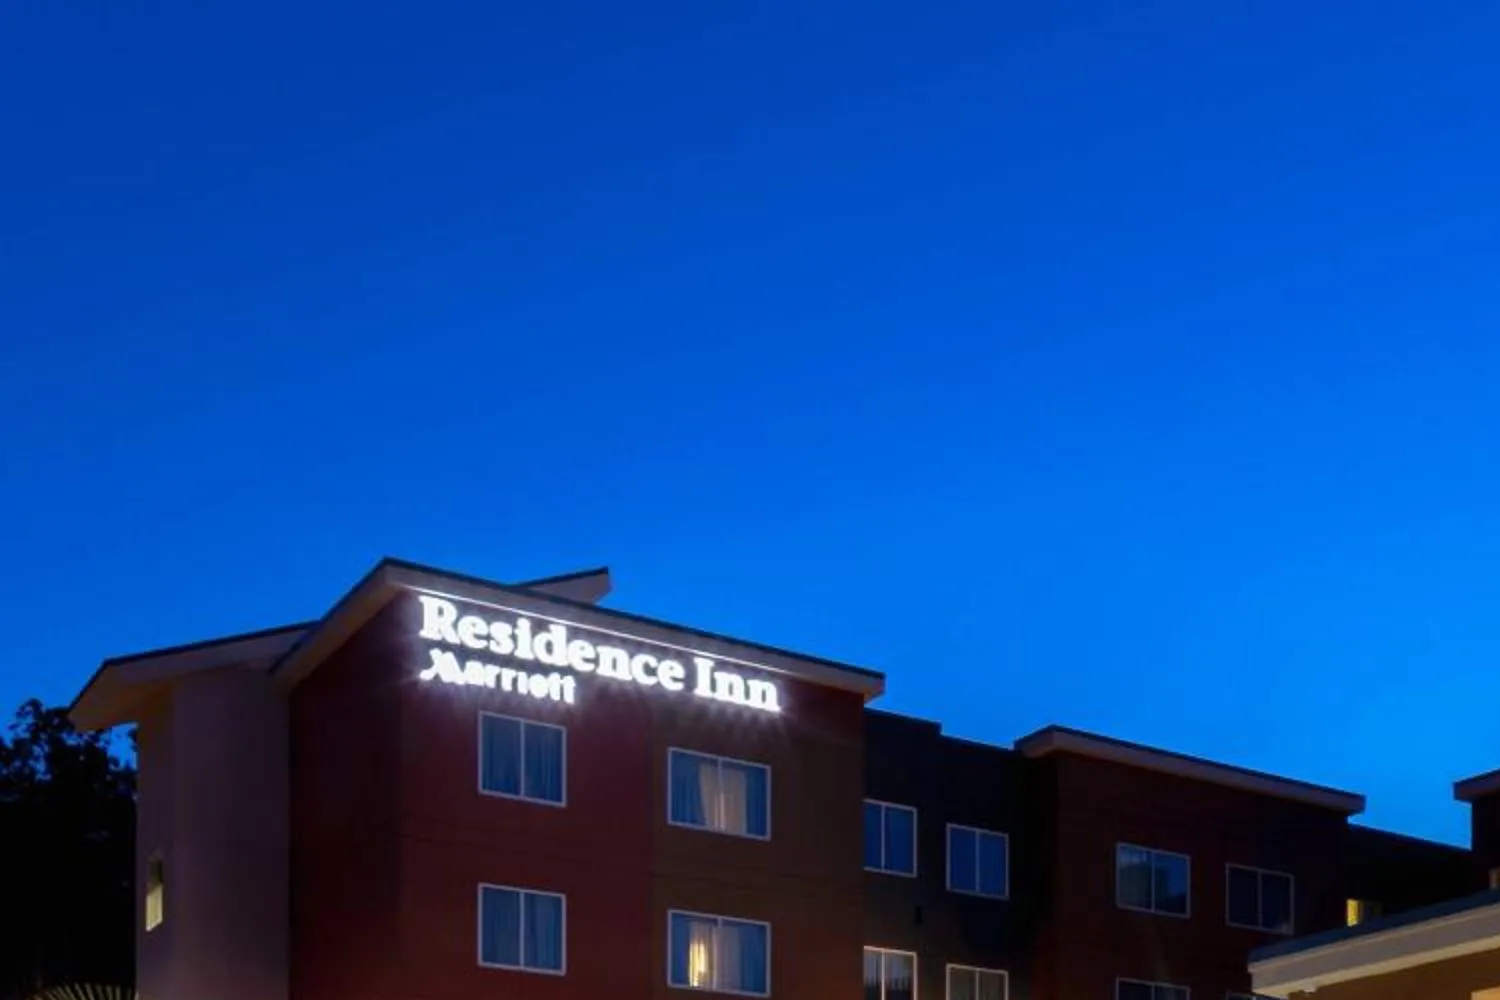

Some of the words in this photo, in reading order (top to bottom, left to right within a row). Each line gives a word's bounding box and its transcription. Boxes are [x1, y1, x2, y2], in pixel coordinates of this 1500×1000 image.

[419, 595, 686, 691] Residence
[693, 656, 782, 713] Inn
[419, 648, 576, 704] Marriott
